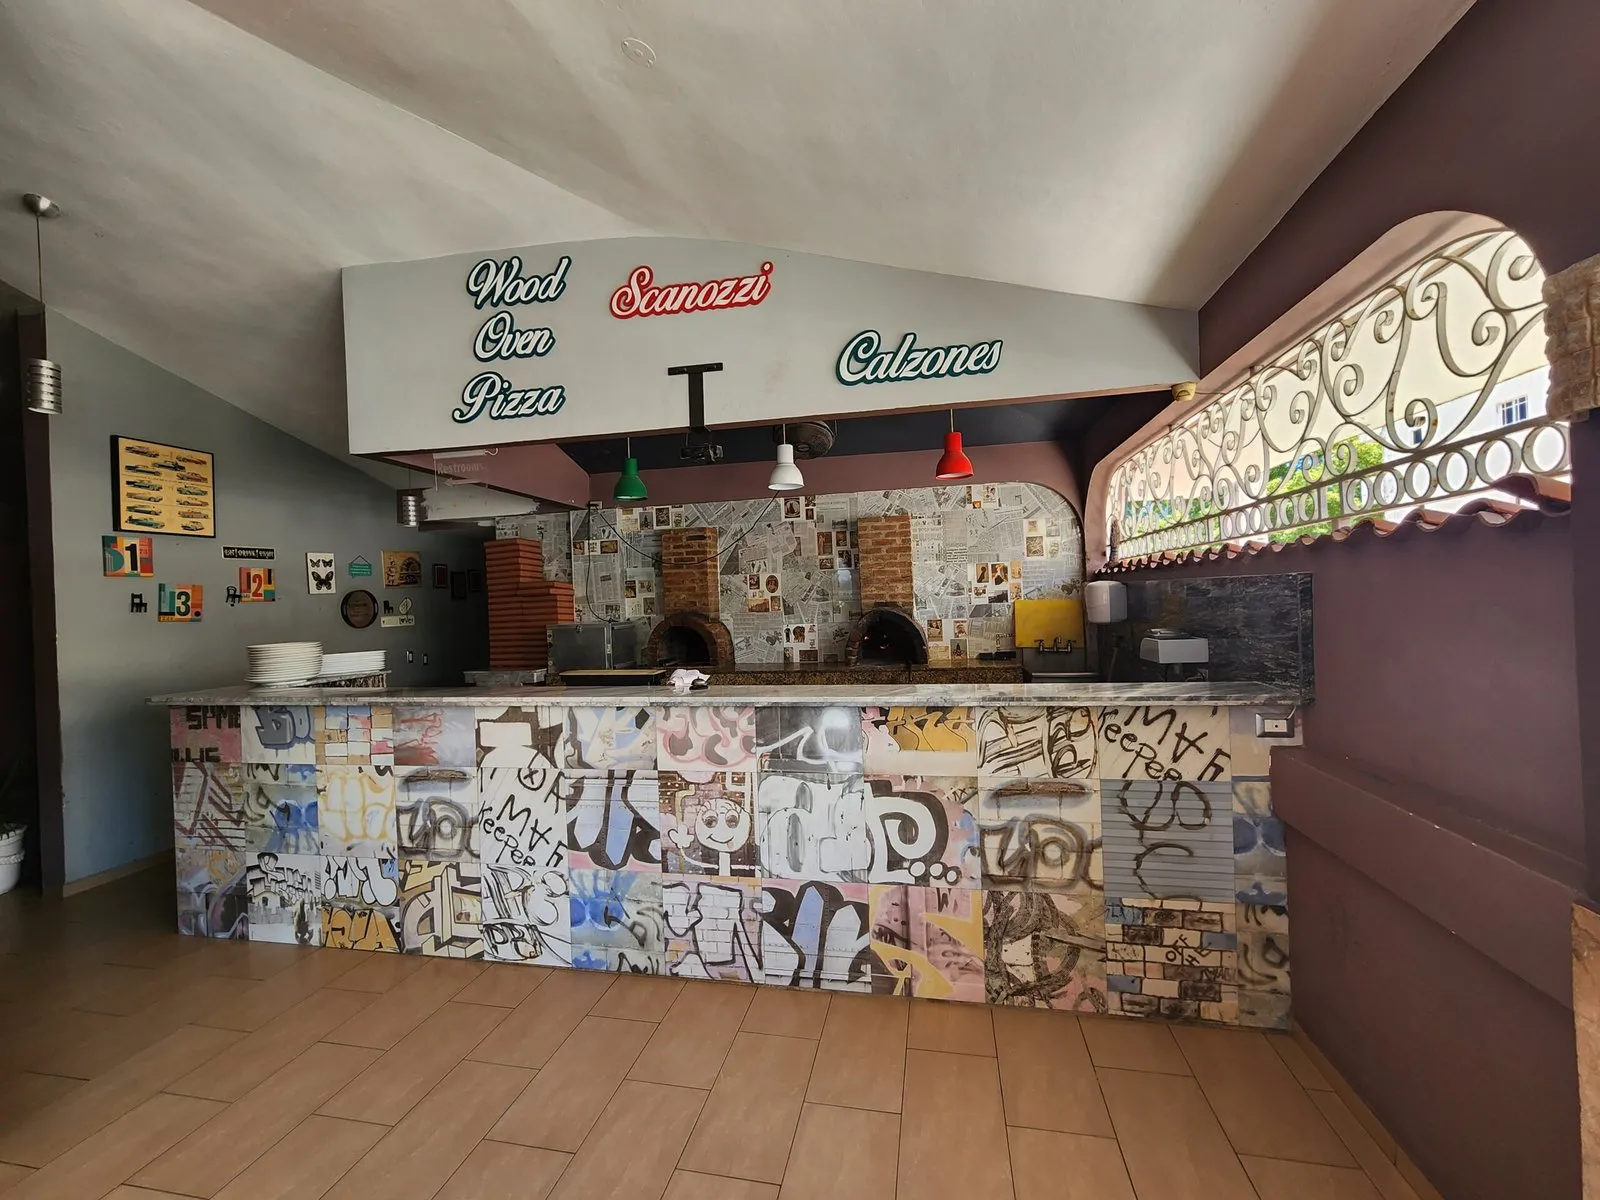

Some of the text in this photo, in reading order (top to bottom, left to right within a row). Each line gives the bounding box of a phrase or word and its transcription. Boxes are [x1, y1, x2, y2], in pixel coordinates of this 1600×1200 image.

[466, 255, 571, 310] Wood
[610, 260, 774, 320] Scanozzi
[473, 310, 556, 362] Oven
[835, 329, 1003, 386] Calzones
[452, 371, 567, 424] Pizza
[437, 463, 485, 475] Restrooms
[125, 543, 138, 571] 1
[176, 591, 190, 616] 3
[252, 574, 262, 597] 2
